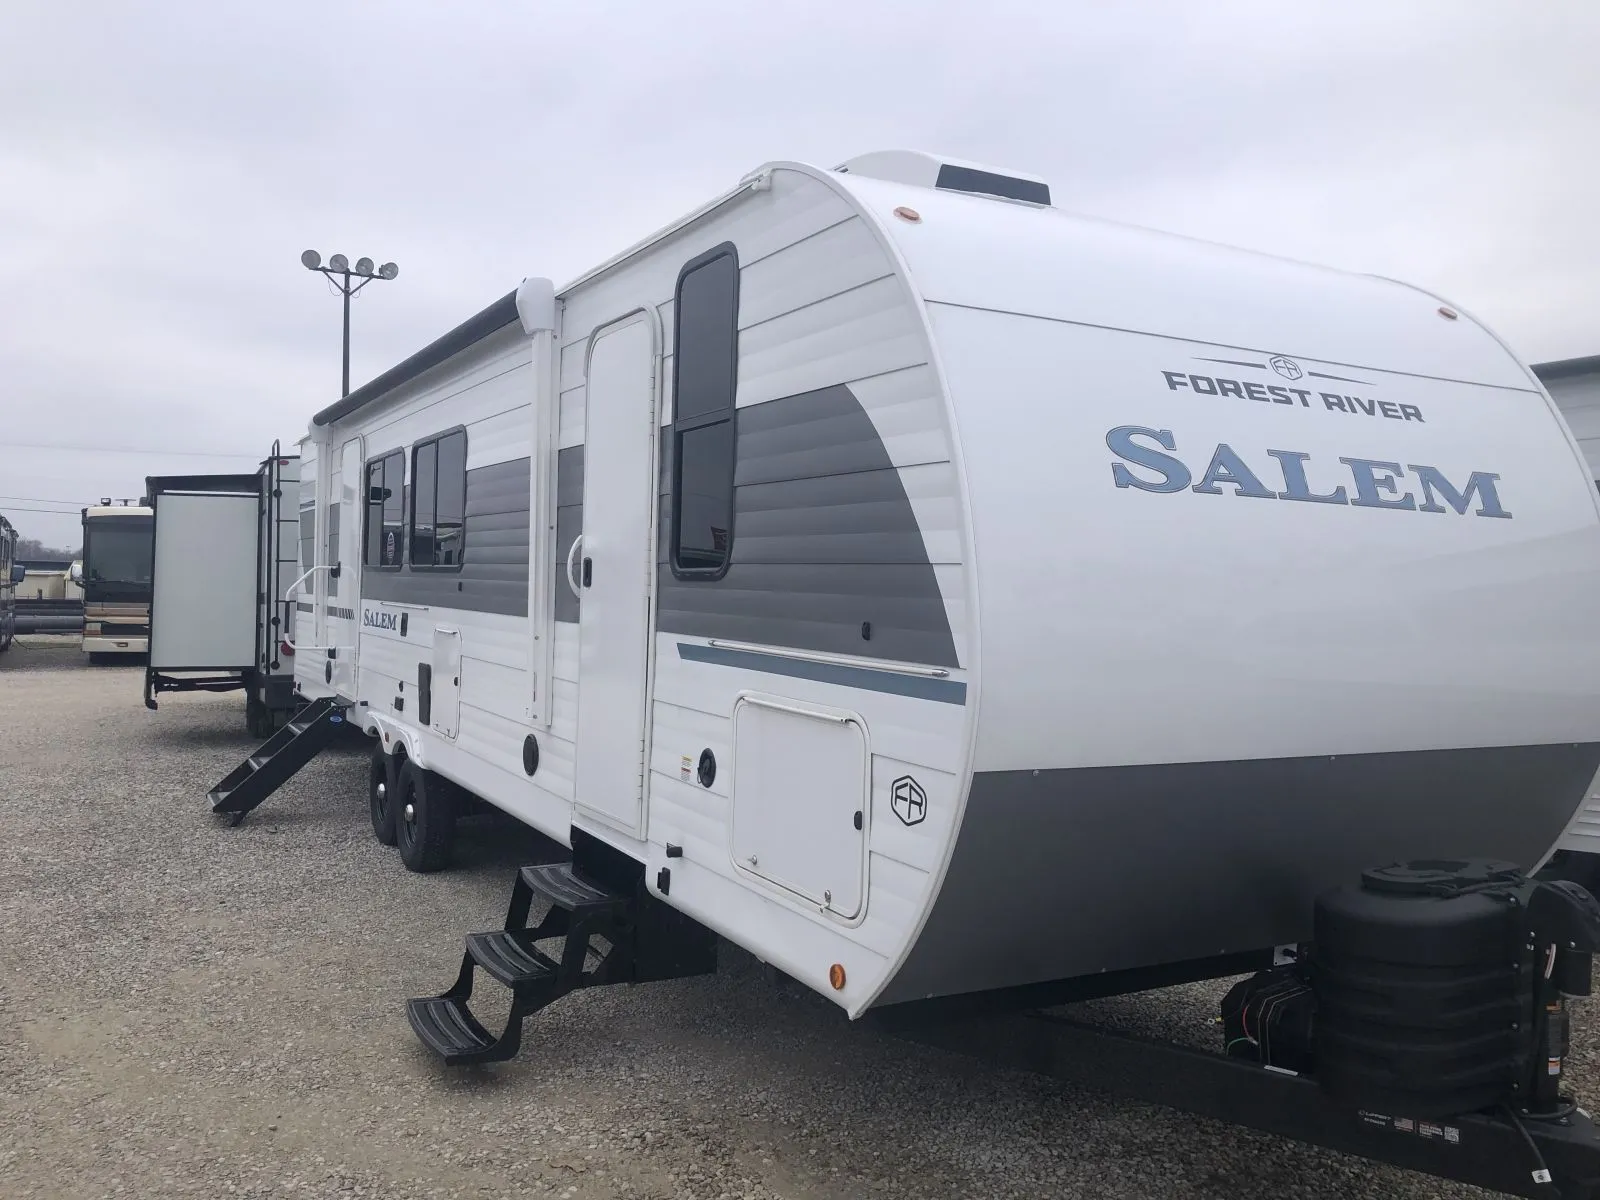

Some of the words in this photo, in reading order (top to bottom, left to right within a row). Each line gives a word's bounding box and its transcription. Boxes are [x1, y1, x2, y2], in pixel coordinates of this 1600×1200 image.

[1161, 370, 1312, 408] FOREST
[1318, 392, 1426, 423] RIVER
[1105, 425, 1513, 520] SALEM
[363, 608, 398, 631] SALEM
